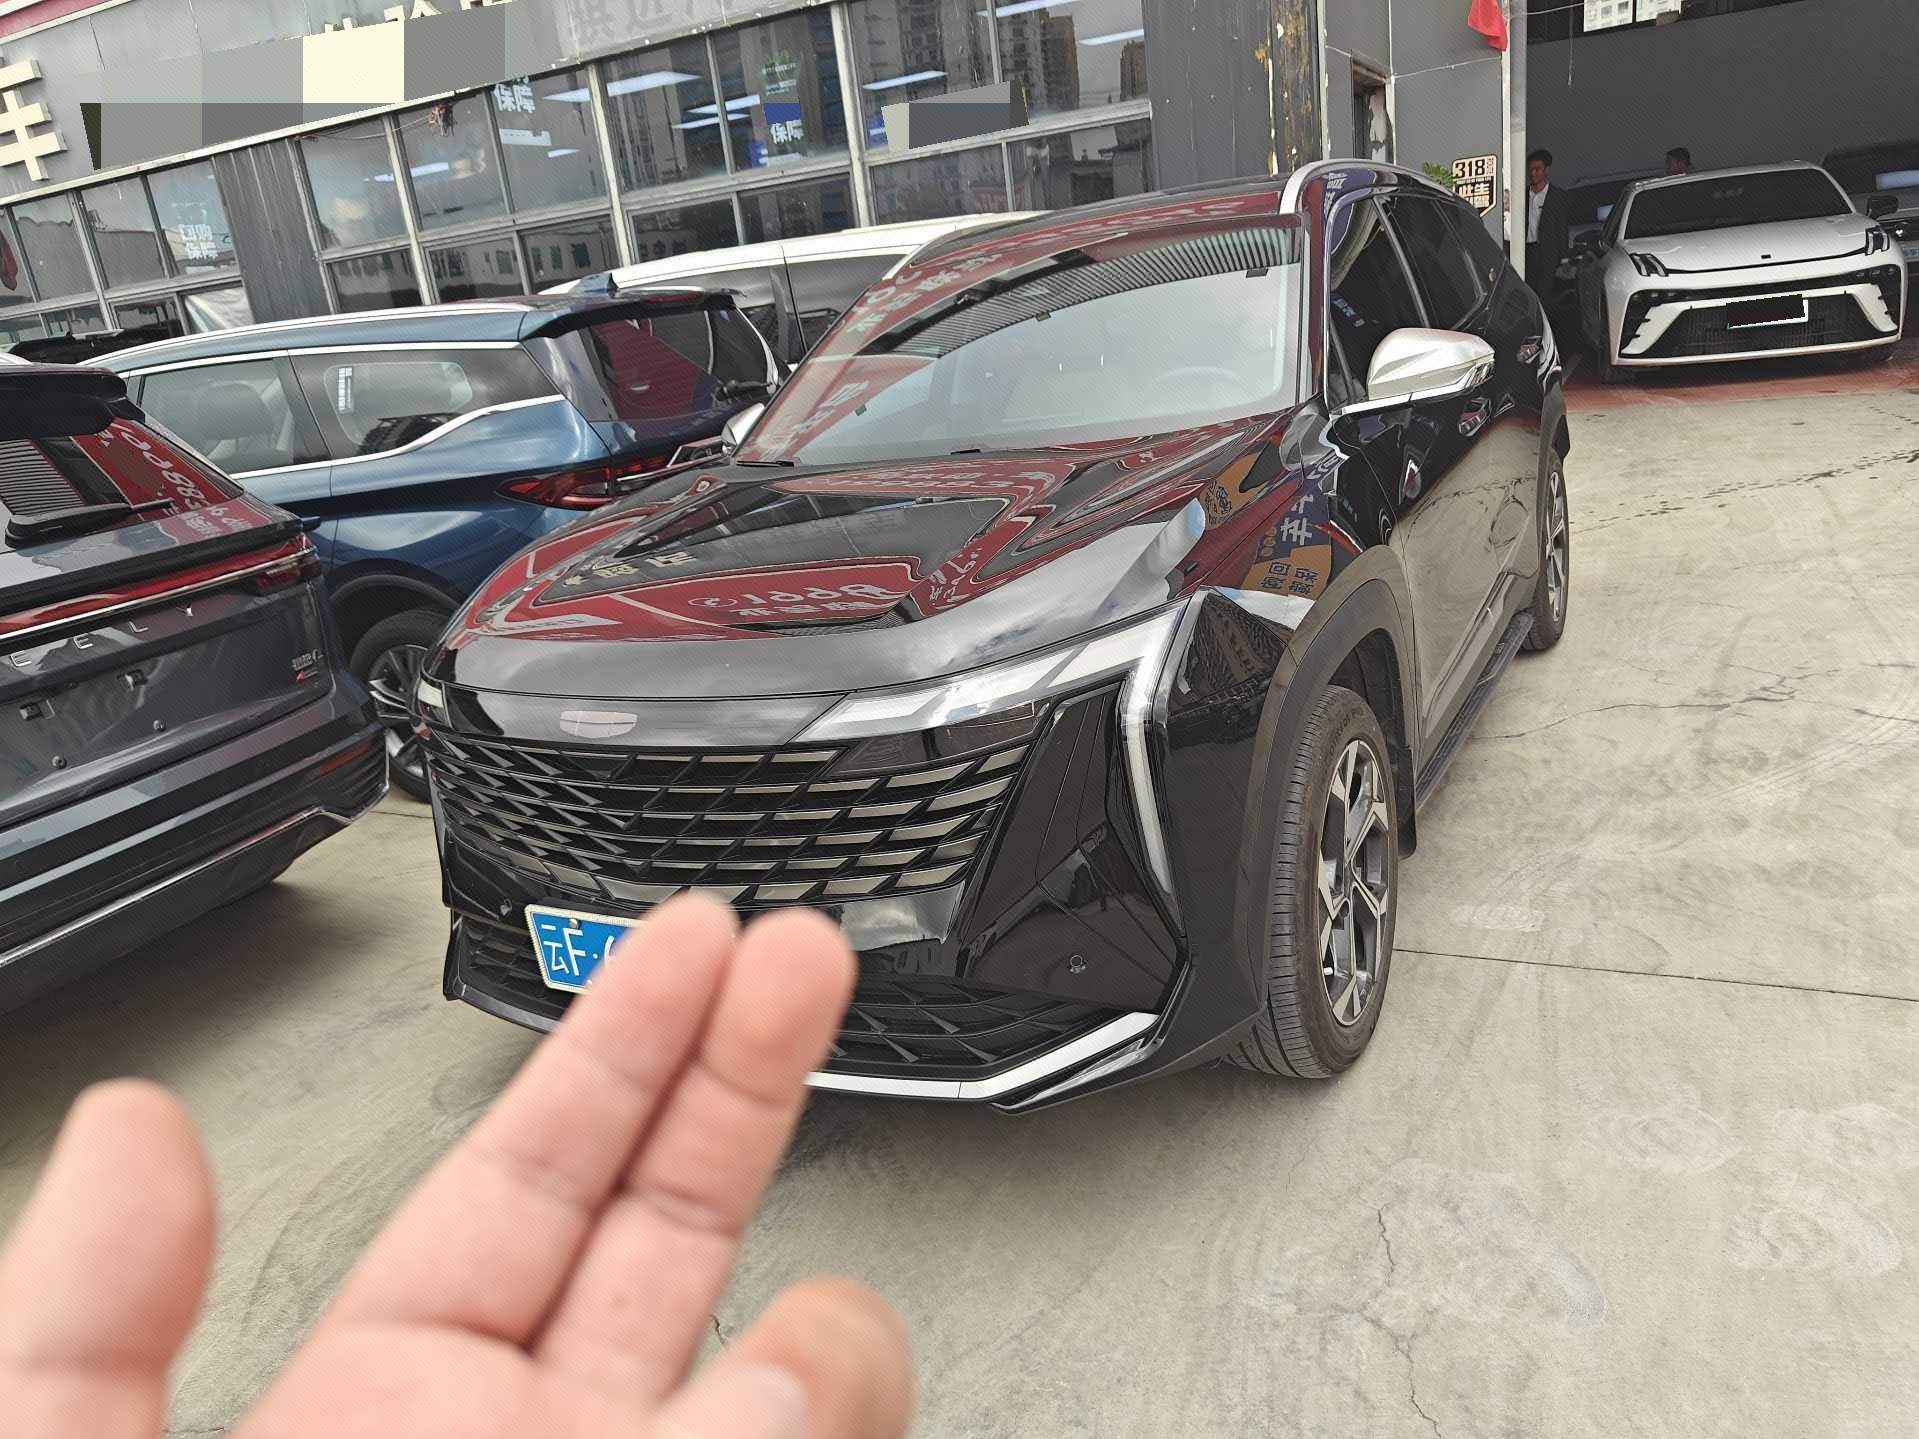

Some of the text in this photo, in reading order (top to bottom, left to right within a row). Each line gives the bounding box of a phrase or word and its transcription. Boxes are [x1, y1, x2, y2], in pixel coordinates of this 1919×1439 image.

[494, 83, 536, 114] 保障
[770, 119, 804, 144] 保障
[1454, 159, 1486, 178] 318
